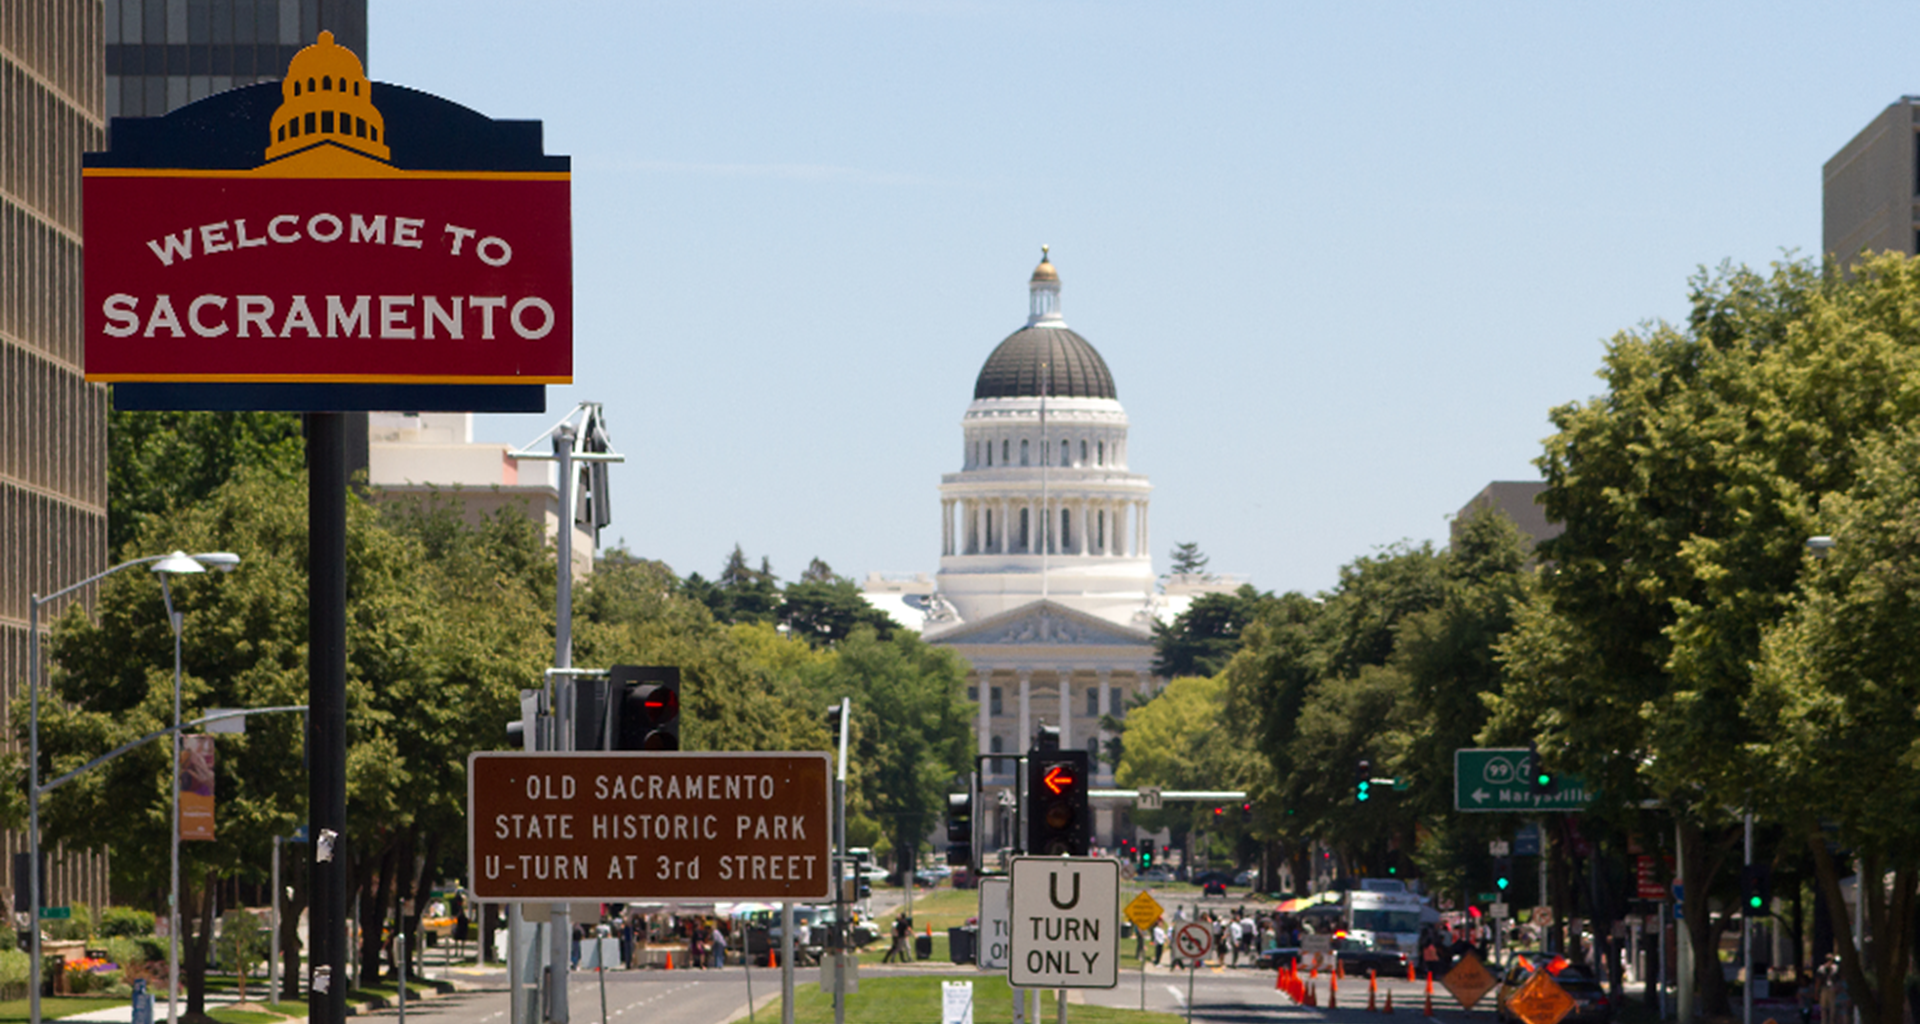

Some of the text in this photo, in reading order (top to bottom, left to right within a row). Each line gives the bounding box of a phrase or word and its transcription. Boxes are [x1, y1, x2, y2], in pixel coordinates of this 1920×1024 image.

[147, 213, 513, 267] WELCOME TO
[102, 293, 555, 340] SACRAMENTO
[1490, 764, 1508, 777] 99
[526, 775, 774, 800] OLD SACRAMENTO
[1500, 788, 1593, 807] Marysville
[495, 814, 806, 840] STATE HISTORIC PARK
[485, 855, 817, 880] U-TURN AT 3rd STREET
[1049, 871, 1081, 910] U
[1029, 916, 1100, 942] TURN
[1027, 949, 1100, 975] ONLY
